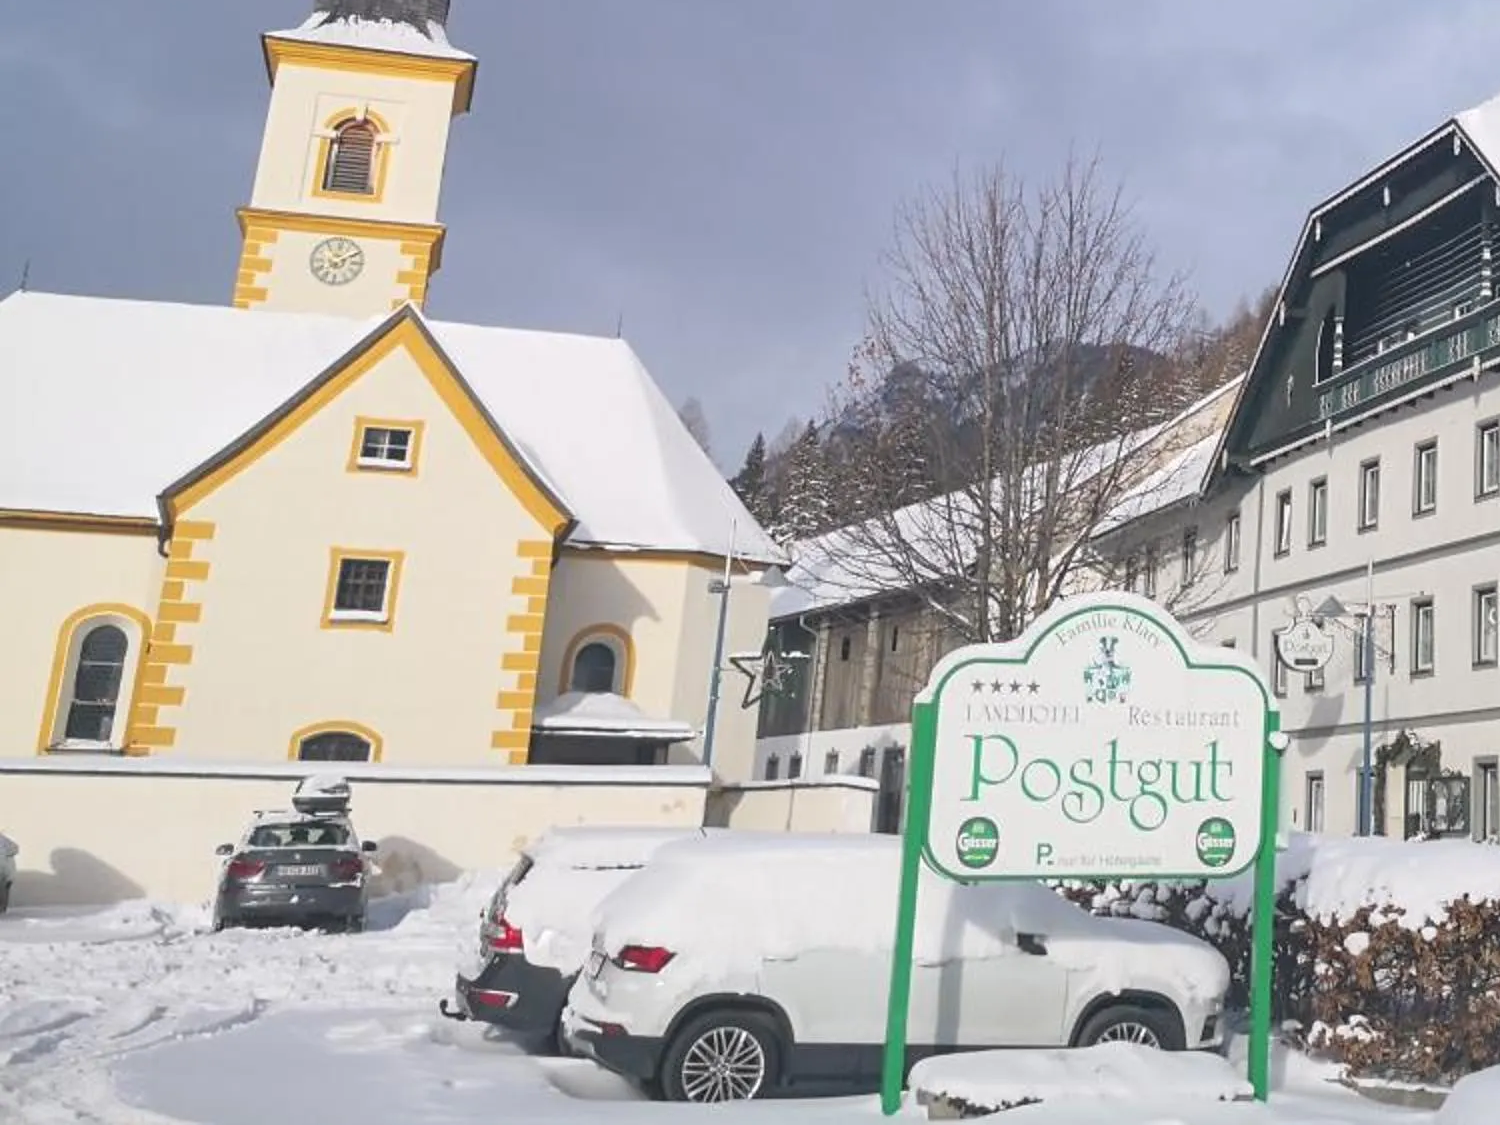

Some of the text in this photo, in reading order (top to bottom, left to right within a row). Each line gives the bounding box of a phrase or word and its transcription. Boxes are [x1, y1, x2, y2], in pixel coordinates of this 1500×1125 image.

[1056, 613, 1119, 647] Familie
[966, 703, 1240, 727] LANDHOTEL Restaurant
[960, 733, 1234, 832] Postgut
